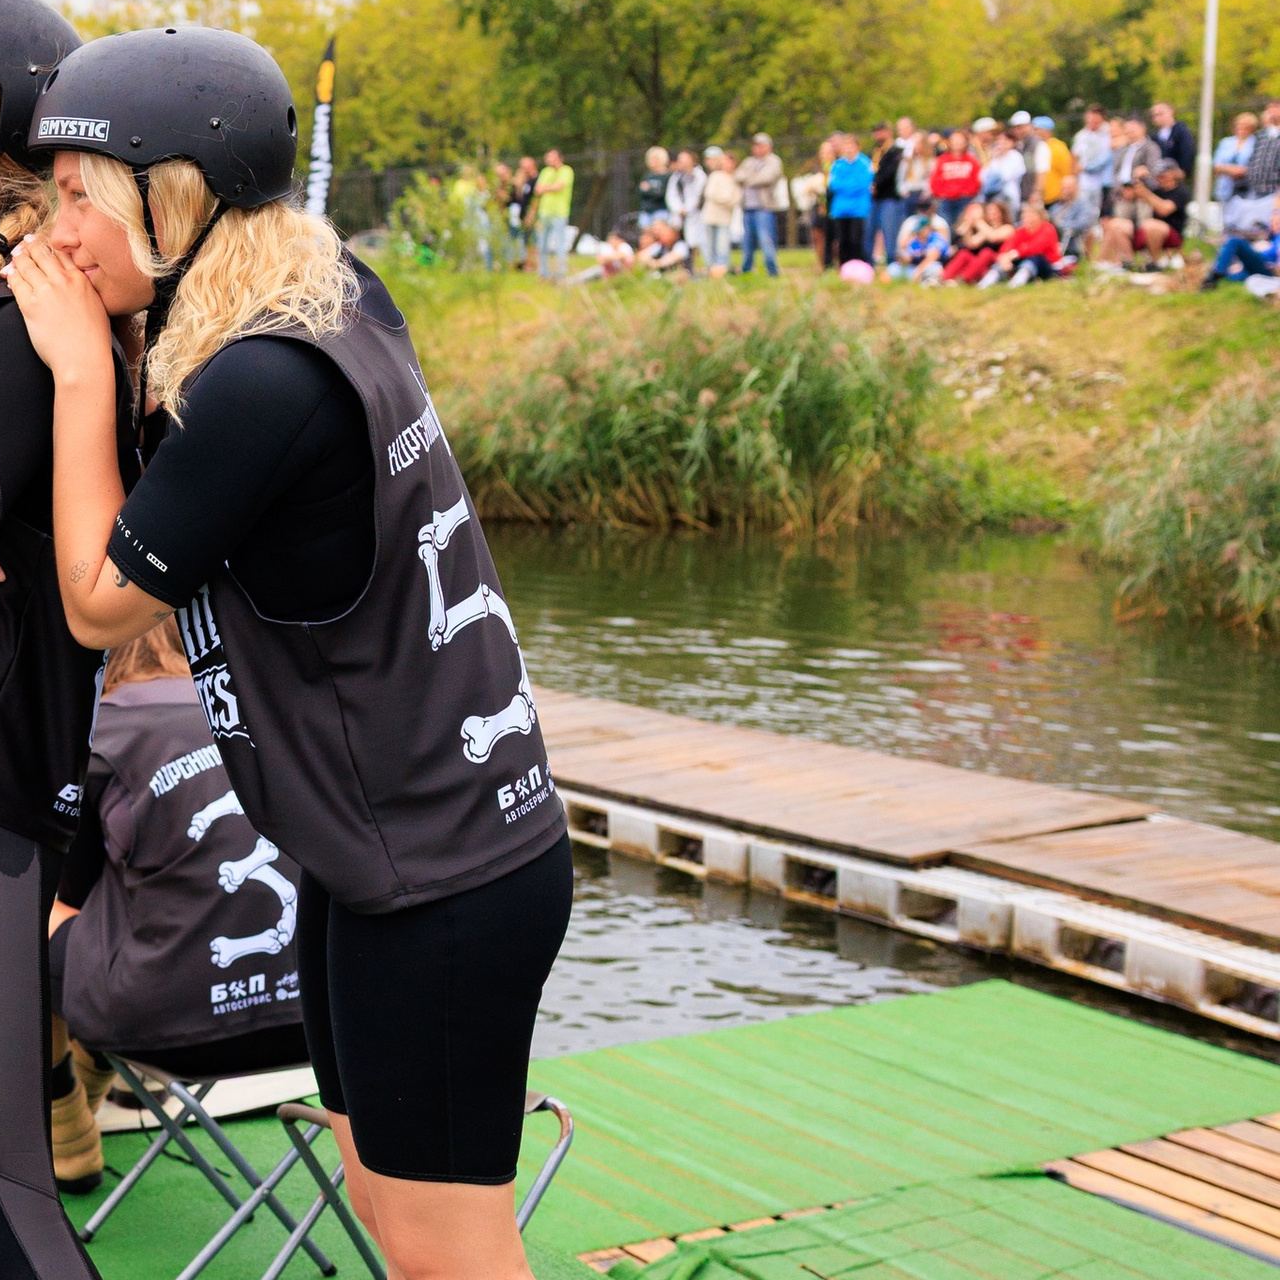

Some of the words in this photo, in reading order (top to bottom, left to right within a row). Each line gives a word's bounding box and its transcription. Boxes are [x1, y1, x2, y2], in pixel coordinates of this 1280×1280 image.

[48, 120, 108, 140] MYSTIC
[149, 743, 224, 798] KUPCHIN
[505, 787, 549, 824] АВТОСЕРВИС
[213, 993, 272, 1015] АВТОСЕРВИС
